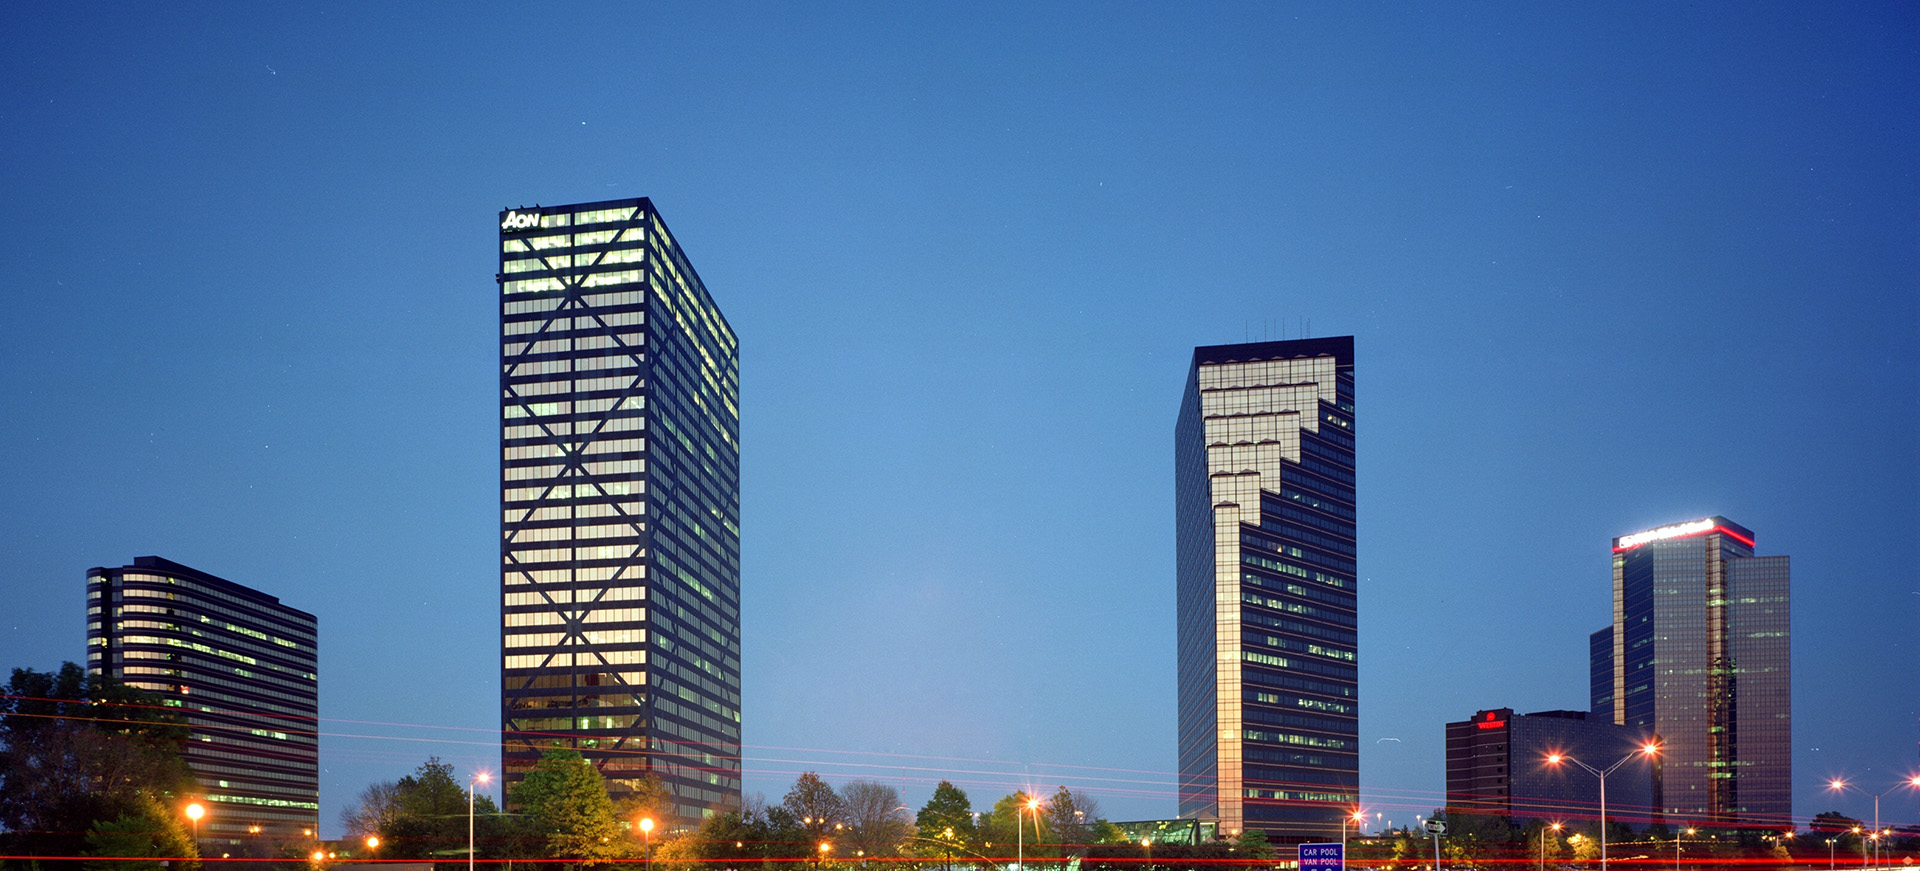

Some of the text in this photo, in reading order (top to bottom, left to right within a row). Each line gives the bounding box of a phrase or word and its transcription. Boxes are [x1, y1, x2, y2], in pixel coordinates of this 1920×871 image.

[501, 210, 540, 229] AON
[1303, 848, 1338, 856] CAR POOL
[1303, 858, 1338, 866] VAN POOL
